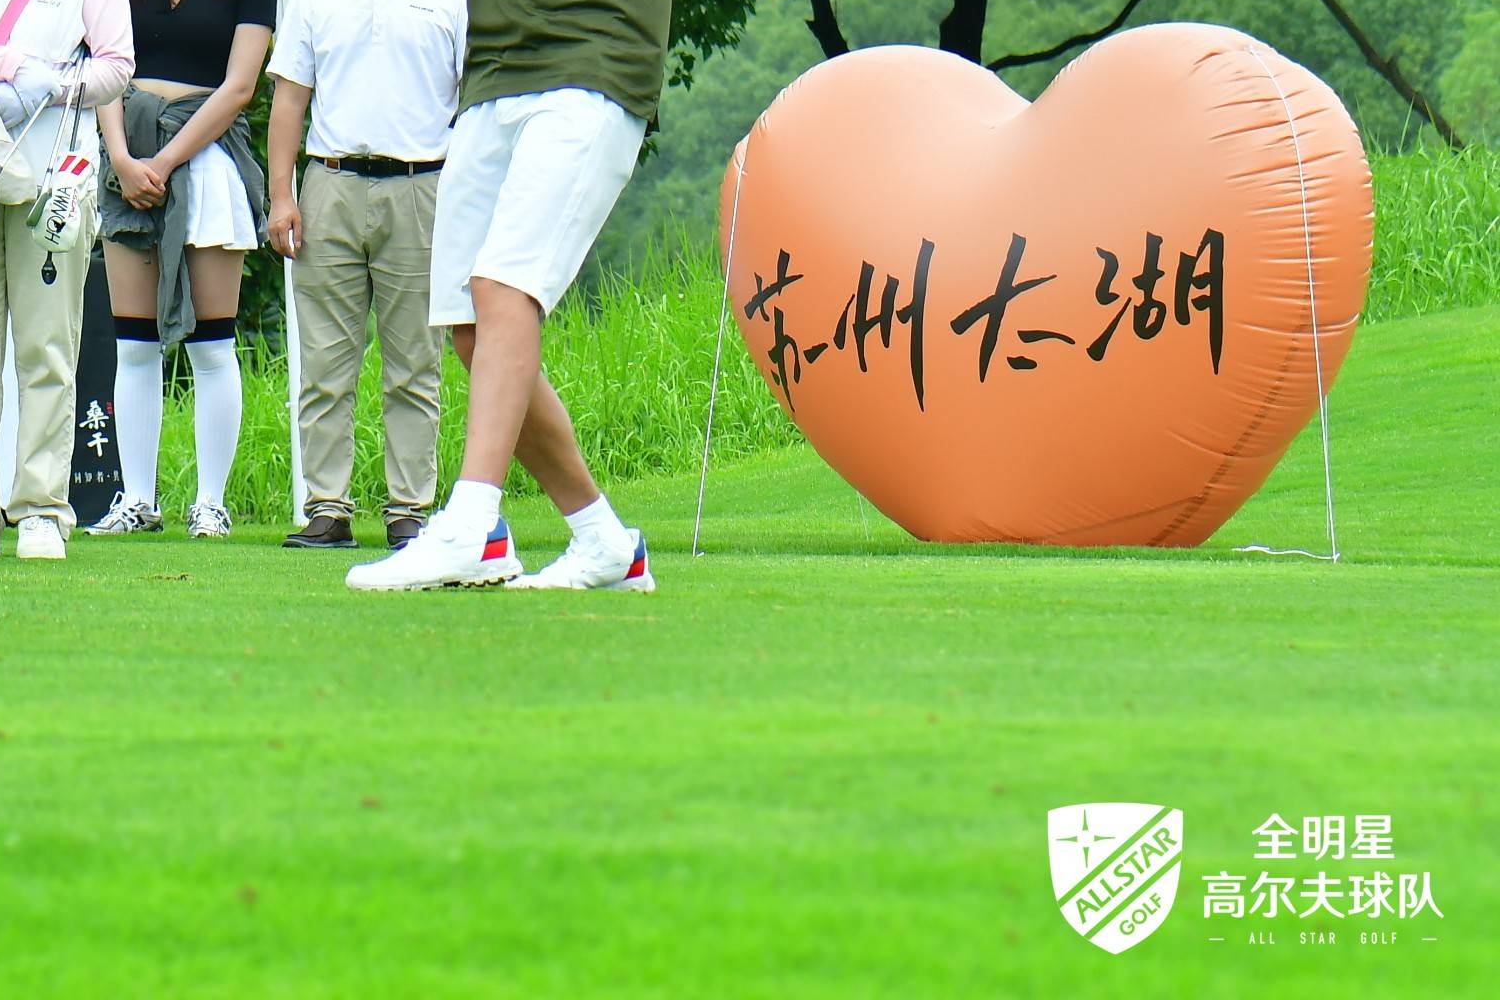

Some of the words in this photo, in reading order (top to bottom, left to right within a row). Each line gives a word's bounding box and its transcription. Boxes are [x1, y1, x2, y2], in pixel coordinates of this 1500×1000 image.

[44, 186, 73, 245] HONMA
[744, 228, 1224, 413] 苏州太湖
[79, 399, 110, 457] 桑干
